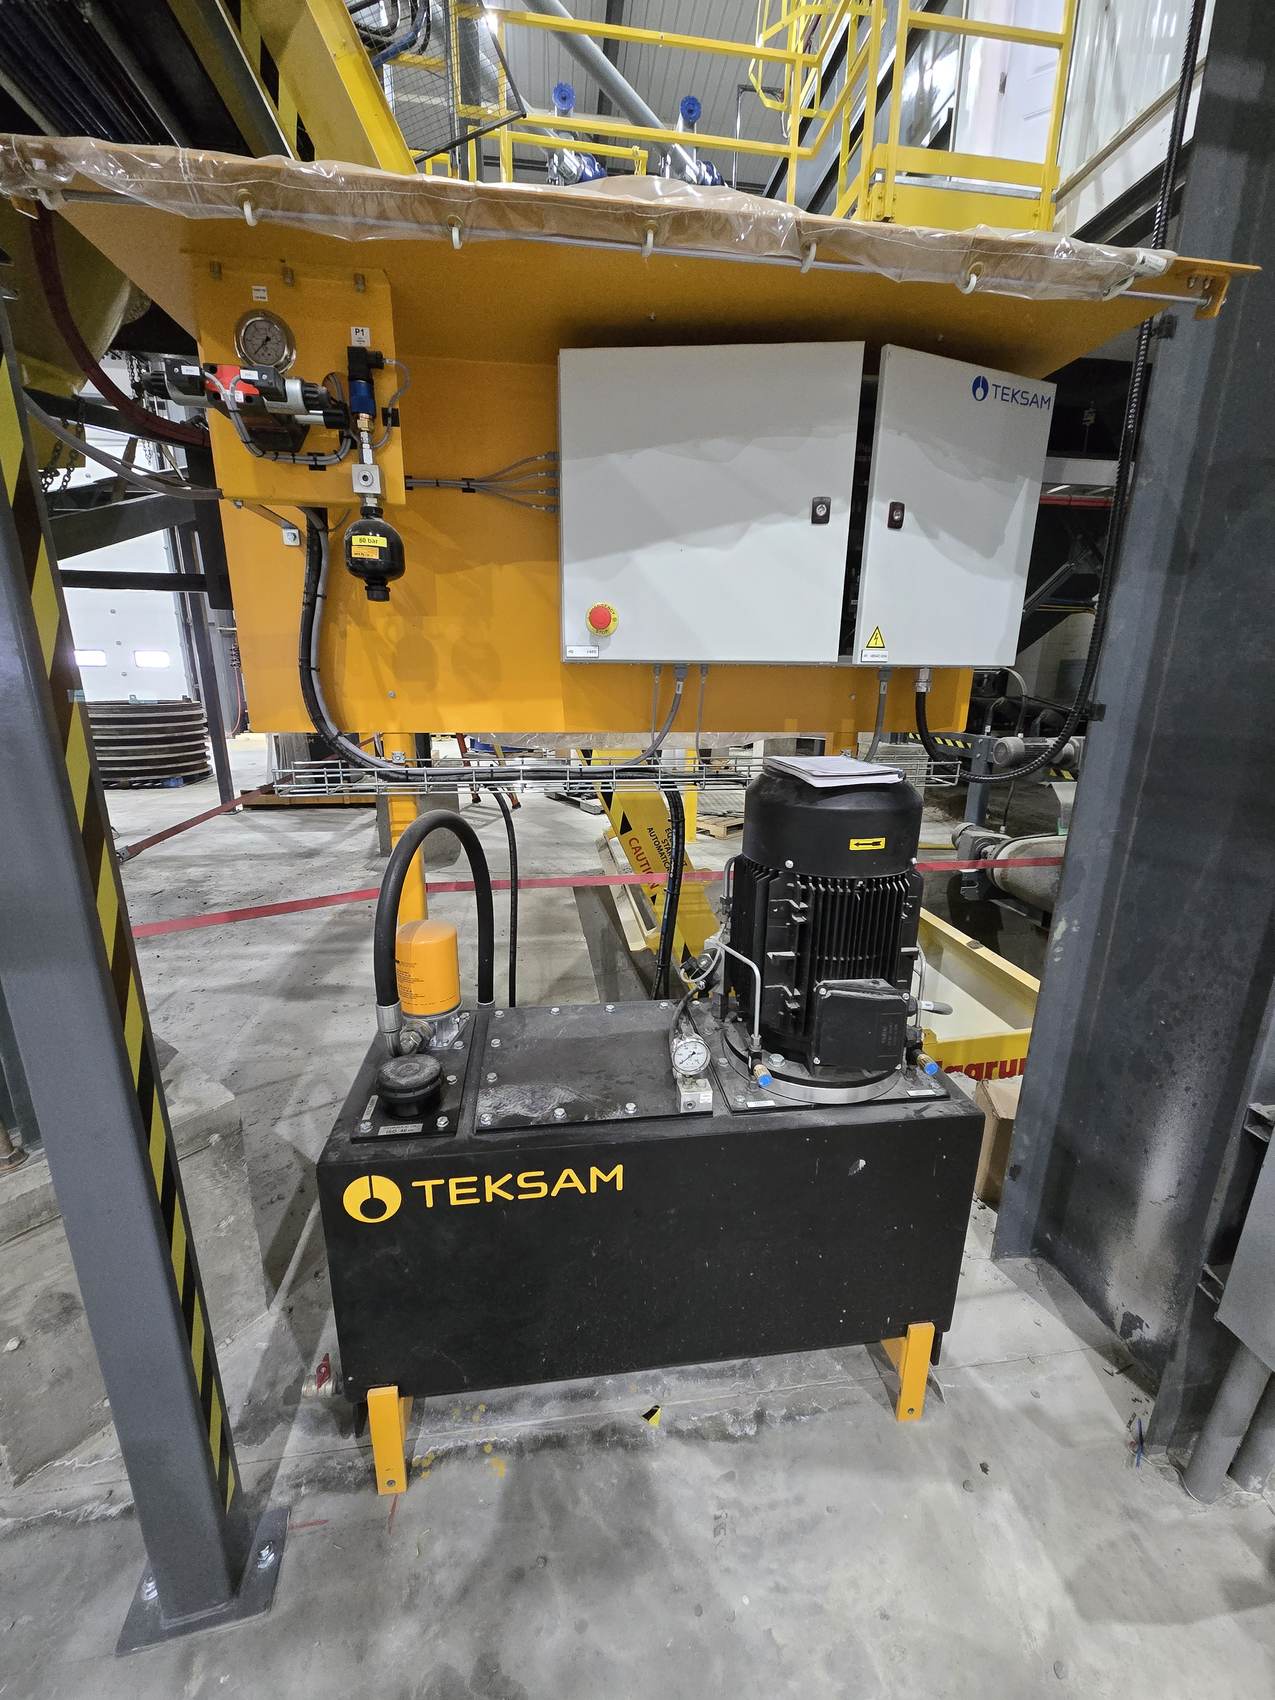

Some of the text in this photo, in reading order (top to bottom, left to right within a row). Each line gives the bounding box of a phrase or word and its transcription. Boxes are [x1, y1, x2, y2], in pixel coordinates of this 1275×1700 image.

[354, 327, 365, 336] P1
[992, 384, 1052, 410] TEKSAM
[628, 837, 660, 890] CAUTIN
[411, 1164, 624, 1208] TEKSAM
